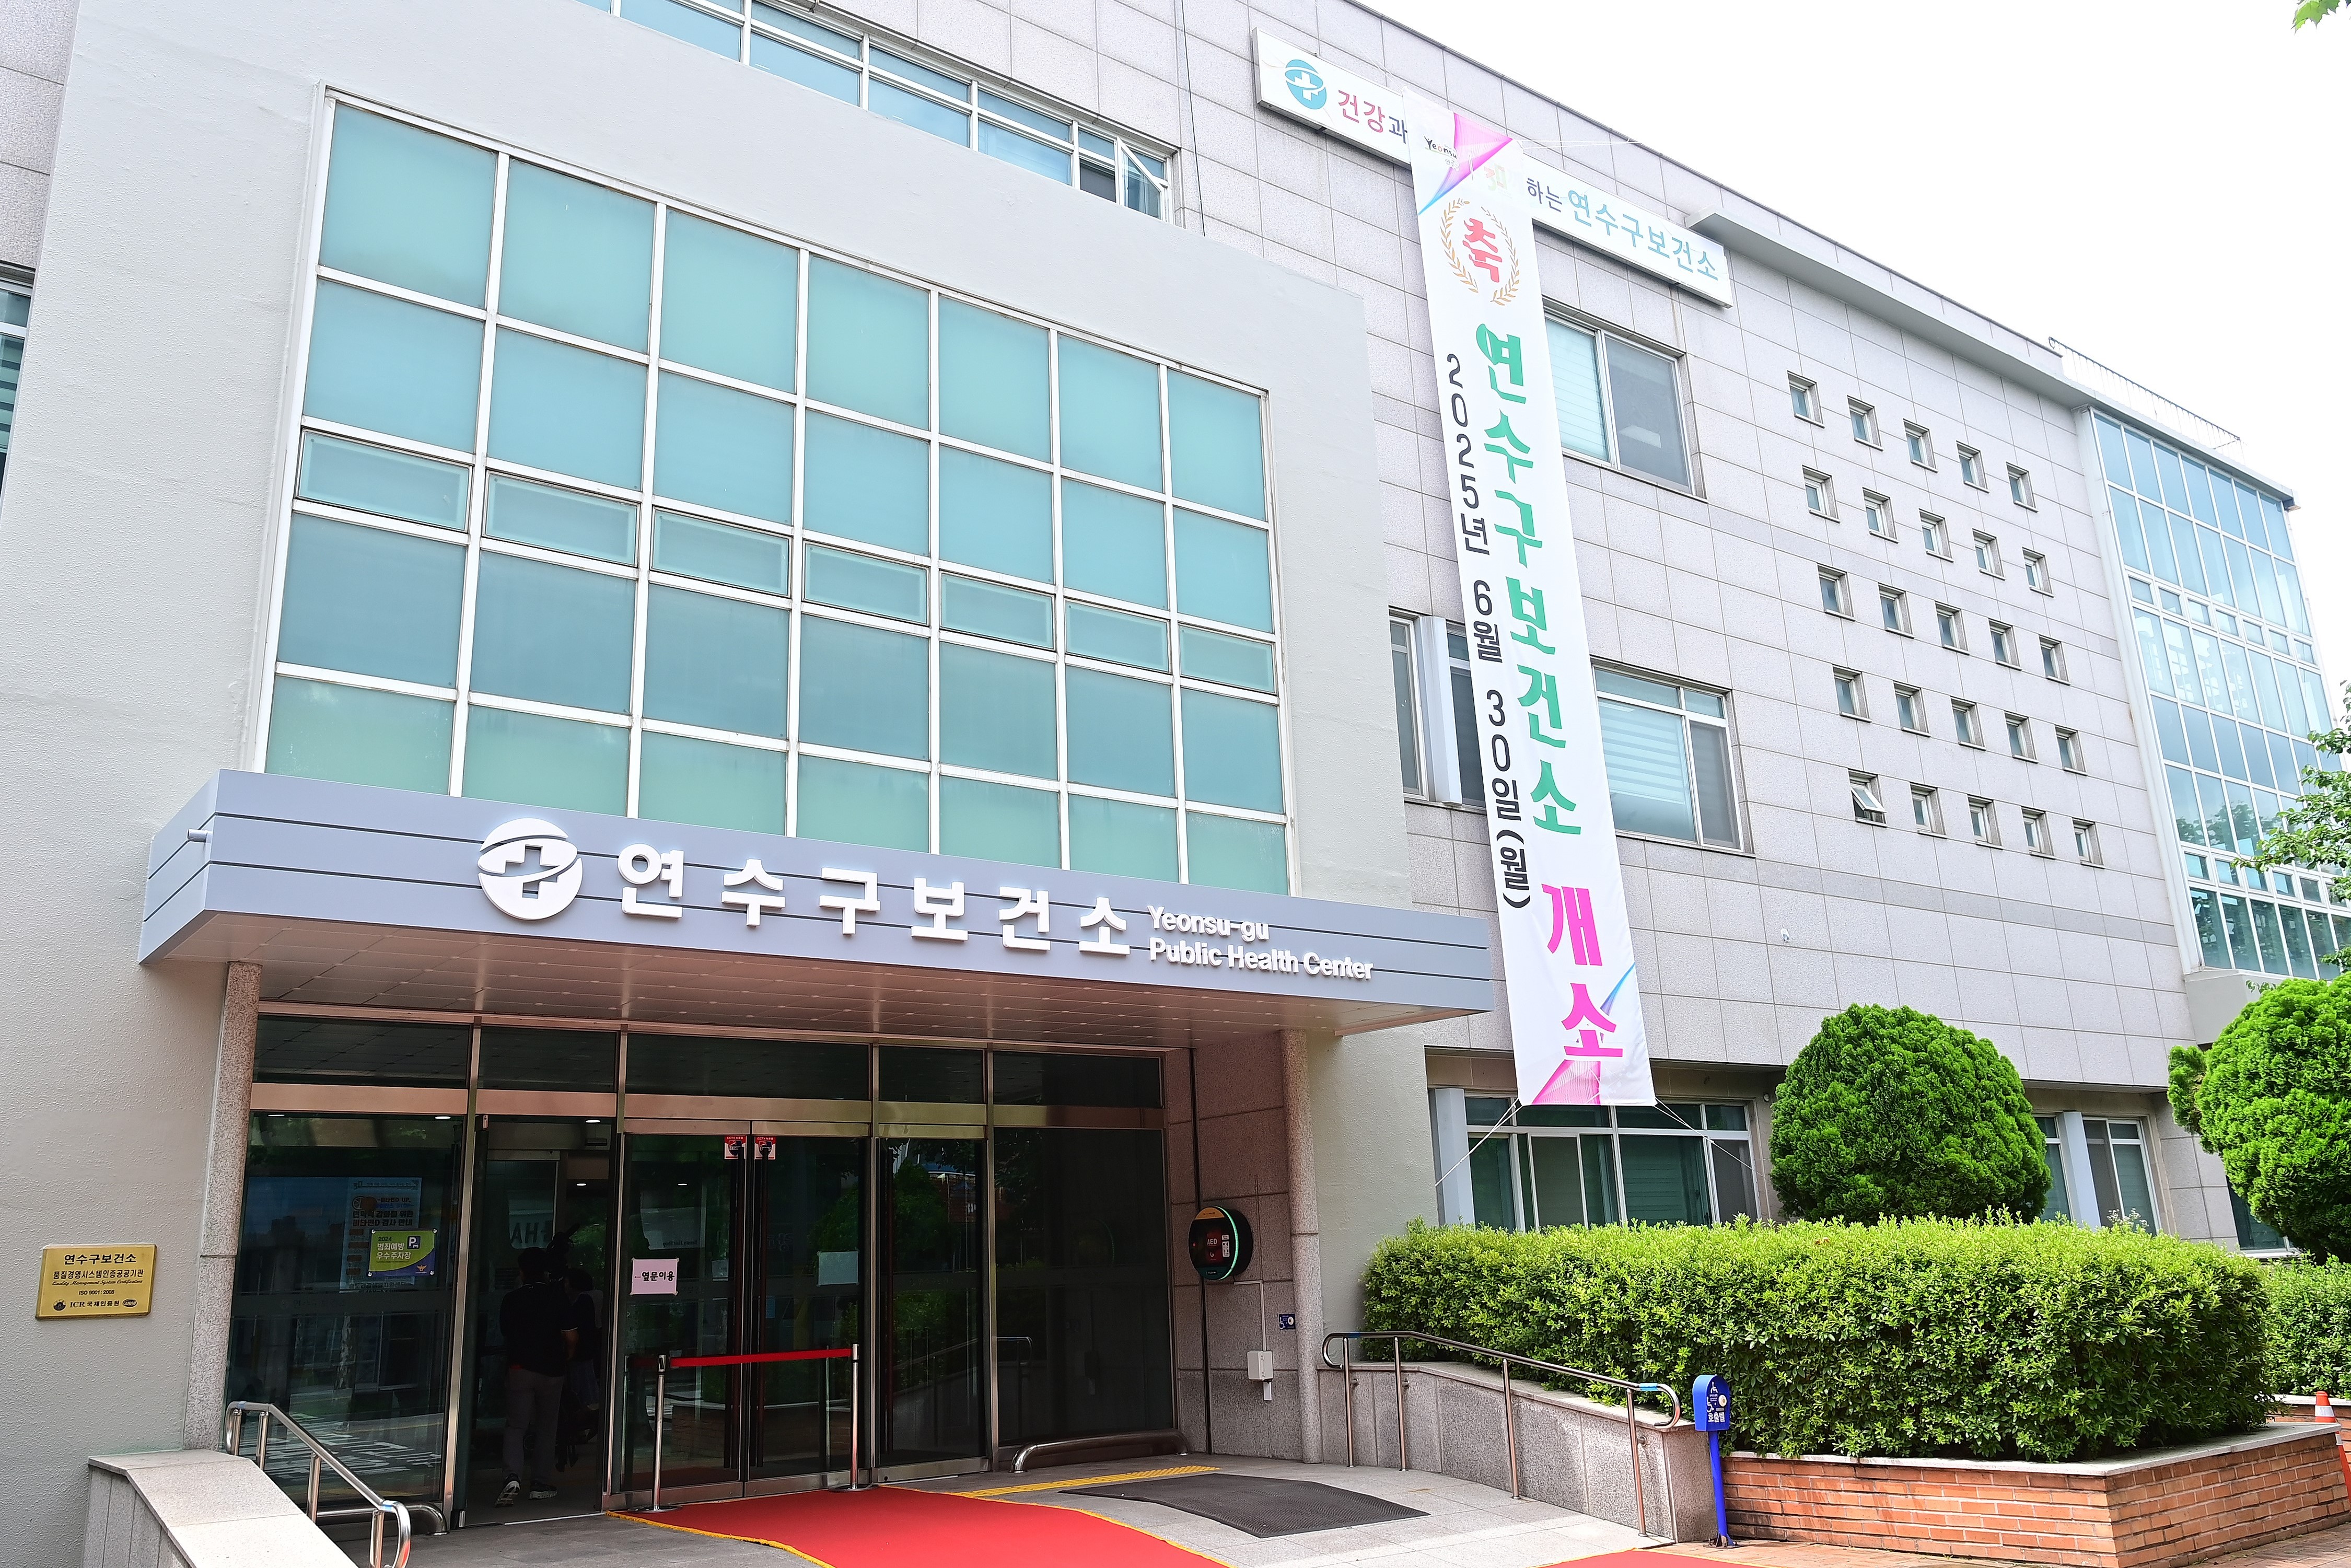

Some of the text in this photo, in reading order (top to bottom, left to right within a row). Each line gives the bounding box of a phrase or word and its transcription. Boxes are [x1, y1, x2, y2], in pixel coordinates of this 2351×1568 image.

[1338, 89, 1407, 144] 건강과
[1424, 136, 1457, 159] Yeonsu
[1462, 218, 1503, 283] 축
[1568, 190, 1718, 281] 연수구보건소
[1447, 353, 1531, 909] 2025년 6월 30일(월)
[1476, 323, 1623, 1058] 연수구보건소 개소
[617, 843, 1131, 955] 연수구보건소
[1147, 904, 1270, 944] Yeonsu-gu
[1149, 936, 1375, 981] Public Health Center
[64, 1253, 137, 1265] 연수구보건소
[376, 1251, 412, 1260] 우수주차장
[377, 1242, 405, 1251] 범죄예방
[53, 1269, 144, 1280] 품질경영시스템인증공공기관
[642, 1271, 674, 1282] 옆문이용
[1708, 1412, 1725, 1423] 호출벨
